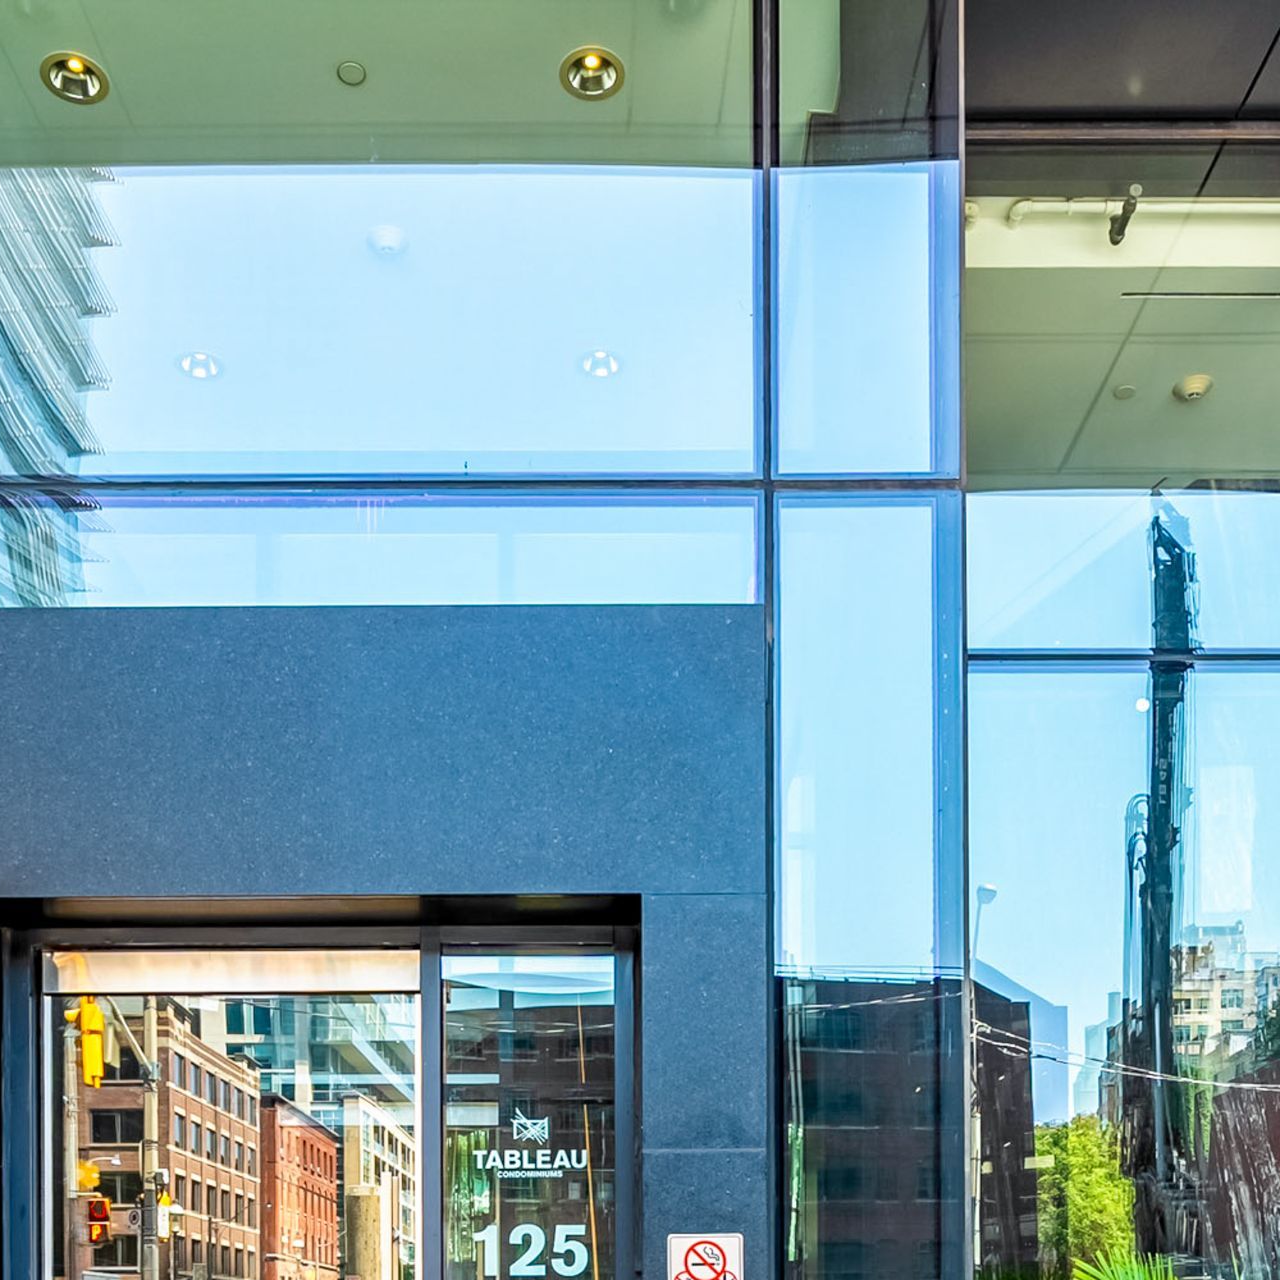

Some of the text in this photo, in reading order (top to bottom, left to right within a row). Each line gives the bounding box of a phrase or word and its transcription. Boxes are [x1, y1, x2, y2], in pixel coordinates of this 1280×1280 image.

[473, 1149, 588, 1169] TABLEAU
[497, 1170, 563, 1179] CONDOMINIUMS
[473, 1223, 589, 1277] 125
